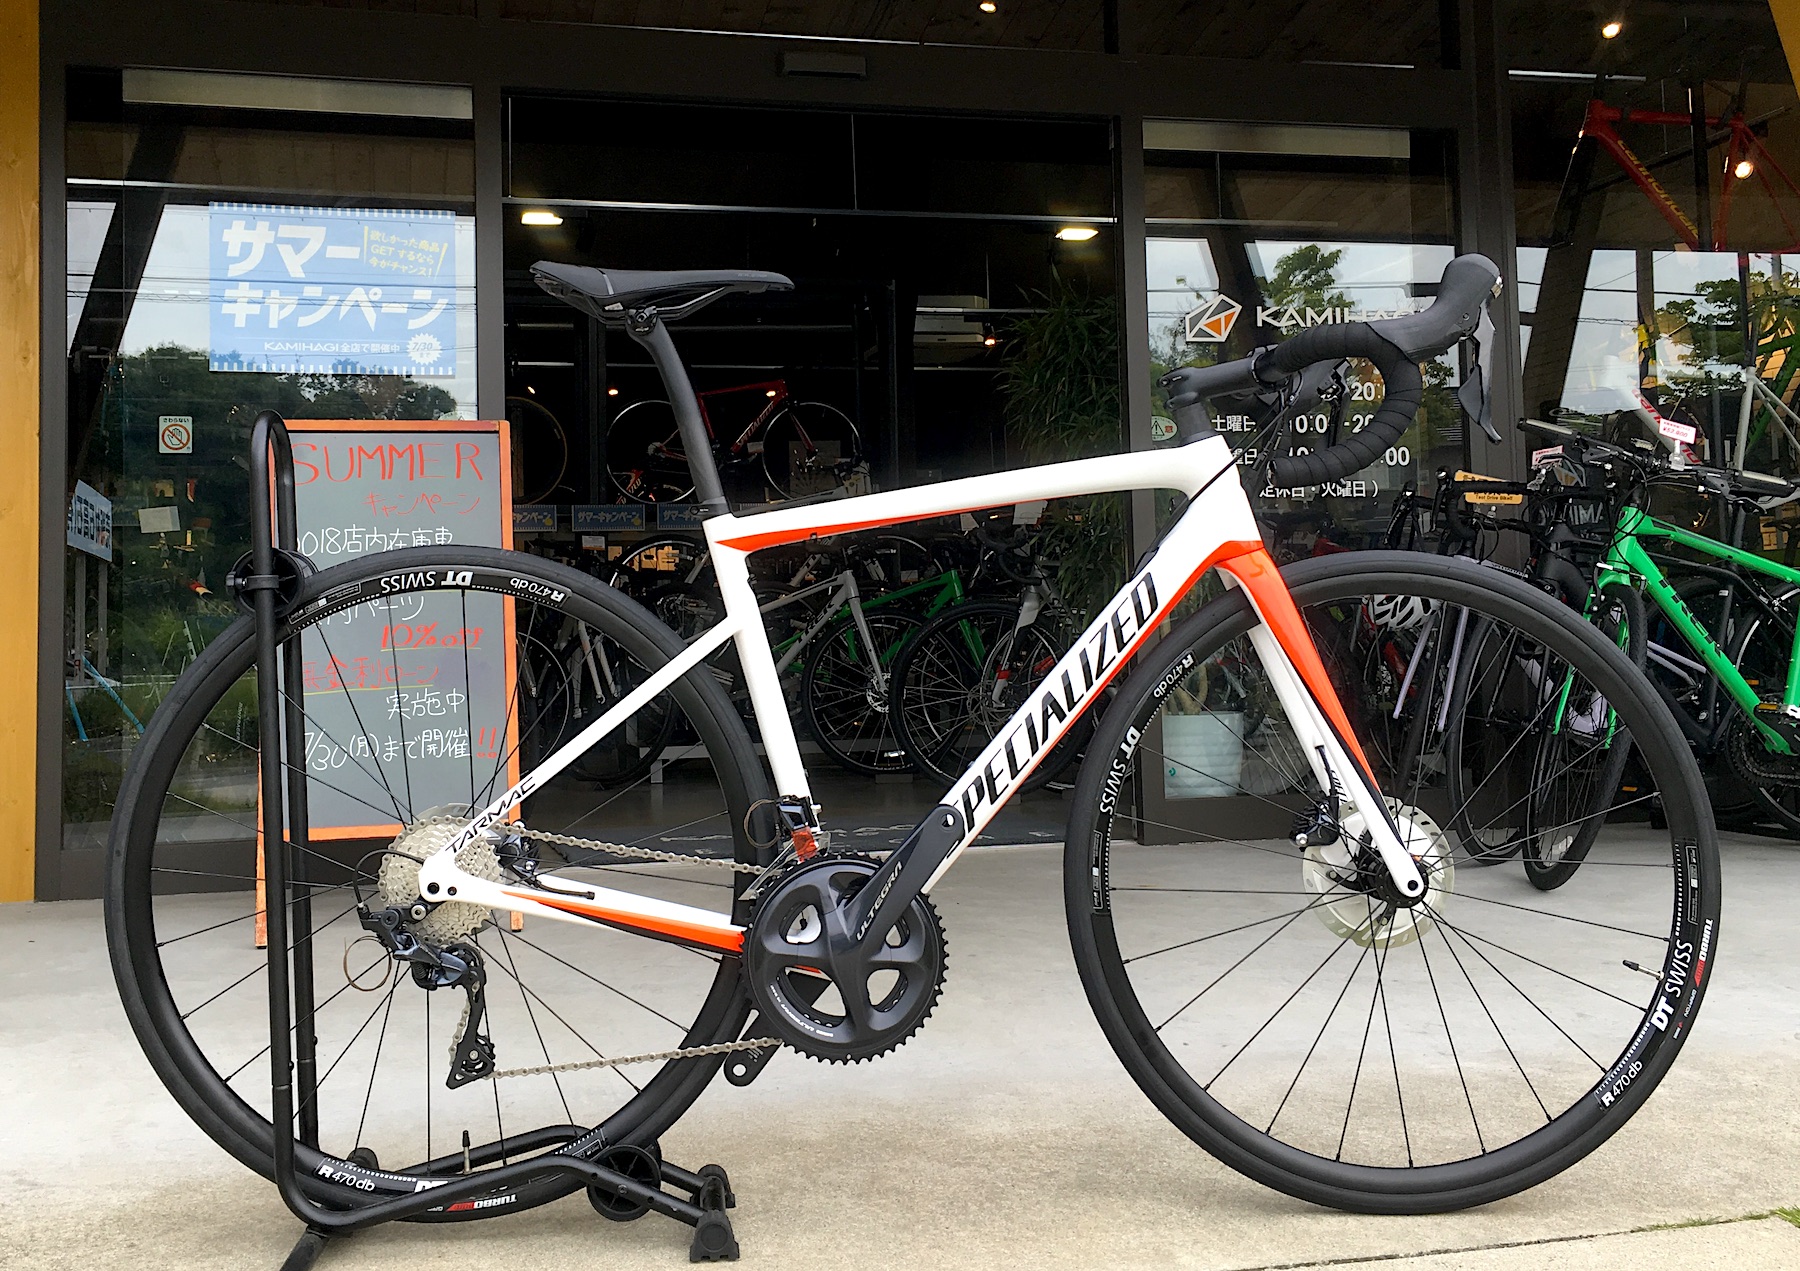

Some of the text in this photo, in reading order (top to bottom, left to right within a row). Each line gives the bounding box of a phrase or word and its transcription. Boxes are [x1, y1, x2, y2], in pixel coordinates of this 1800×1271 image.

[221, 219, 361, 278] サマー
[369, 230, 440, 253] 欲しかった商品
[370, 244, 434, 265] GET するなら
[221, 281, 450, 333] キャンペーン
[263, 341, 340, 353] KAMIHAGI
[291, 442, 484, 486] SUMMER
[361, 491, 481, 518] キャンペーン
[297, 524, 454, 557] 018店内在庫車
[380, 570, 474, 593] DT SWISS
[380, 621, 439, 649] 10%
[386, 687, 466, 719] 実施中
[946, 572, 1159, 859] PECIALIZED
[1099, 724, 1142, 816] DT SWISS
[445, 776, 536, 854] TARMAC
[856, 861, 903, 941] ULTEGRA
[1699, 918, 1714, 962] TURBO
[1650, 938, 1694, 1032] DT SWISS
[473, 1194, 518, 1210] TURBO
